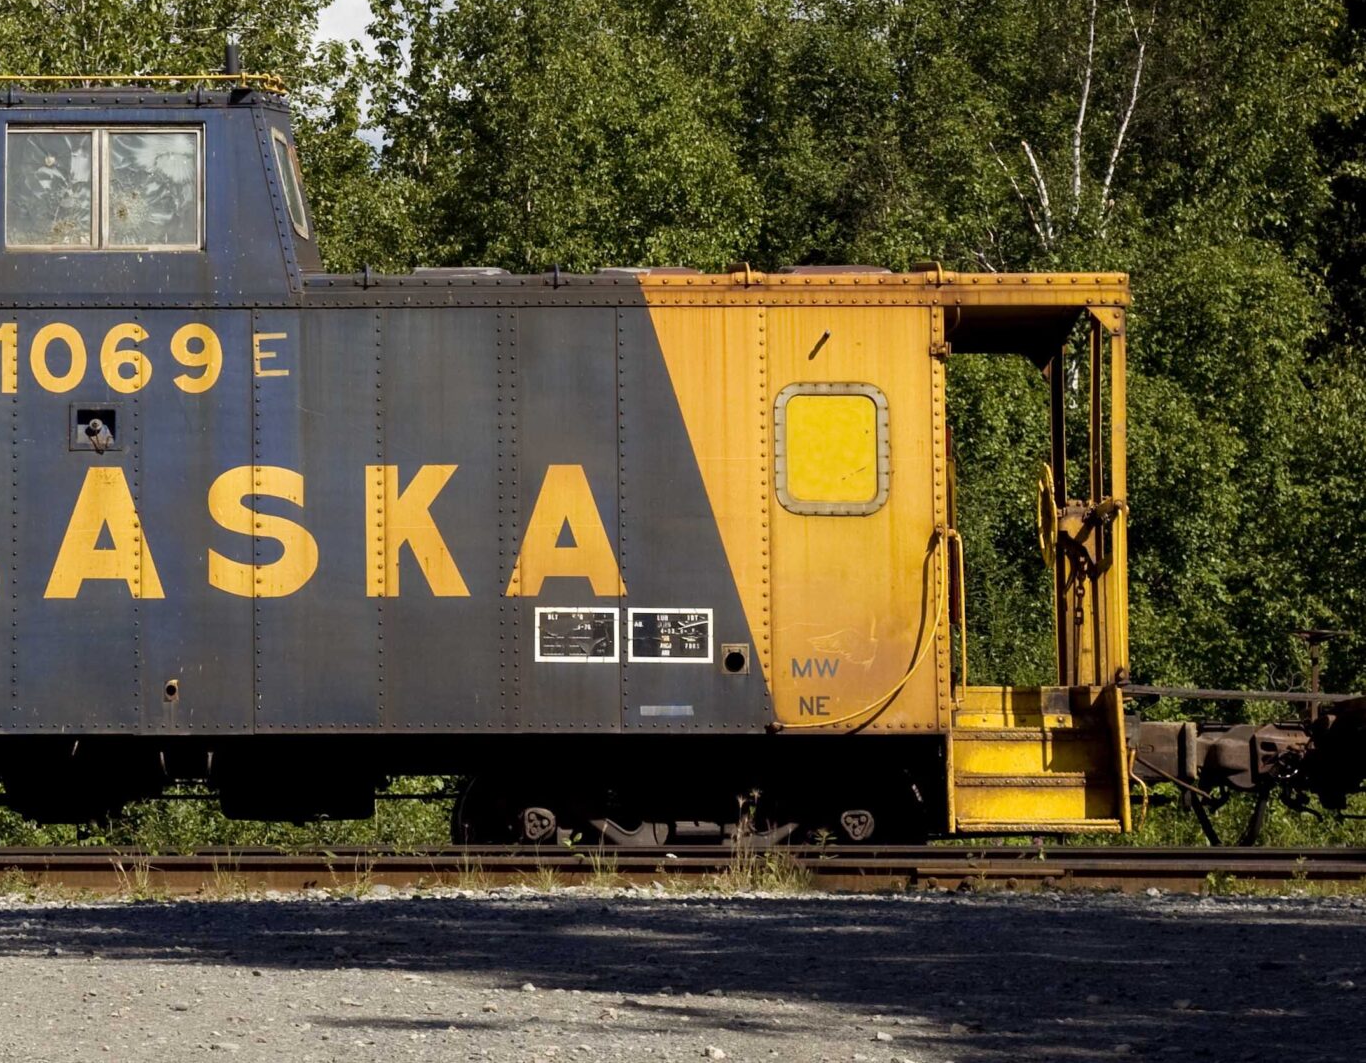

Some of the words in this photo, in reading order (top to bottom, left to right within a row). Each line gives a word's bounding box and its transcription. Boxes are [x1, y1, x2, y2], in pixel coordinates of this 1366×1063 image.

[253, 332, 289, 377] E
[791, 657, 840, 678] MW
[799, 696, 831, 716] NE
